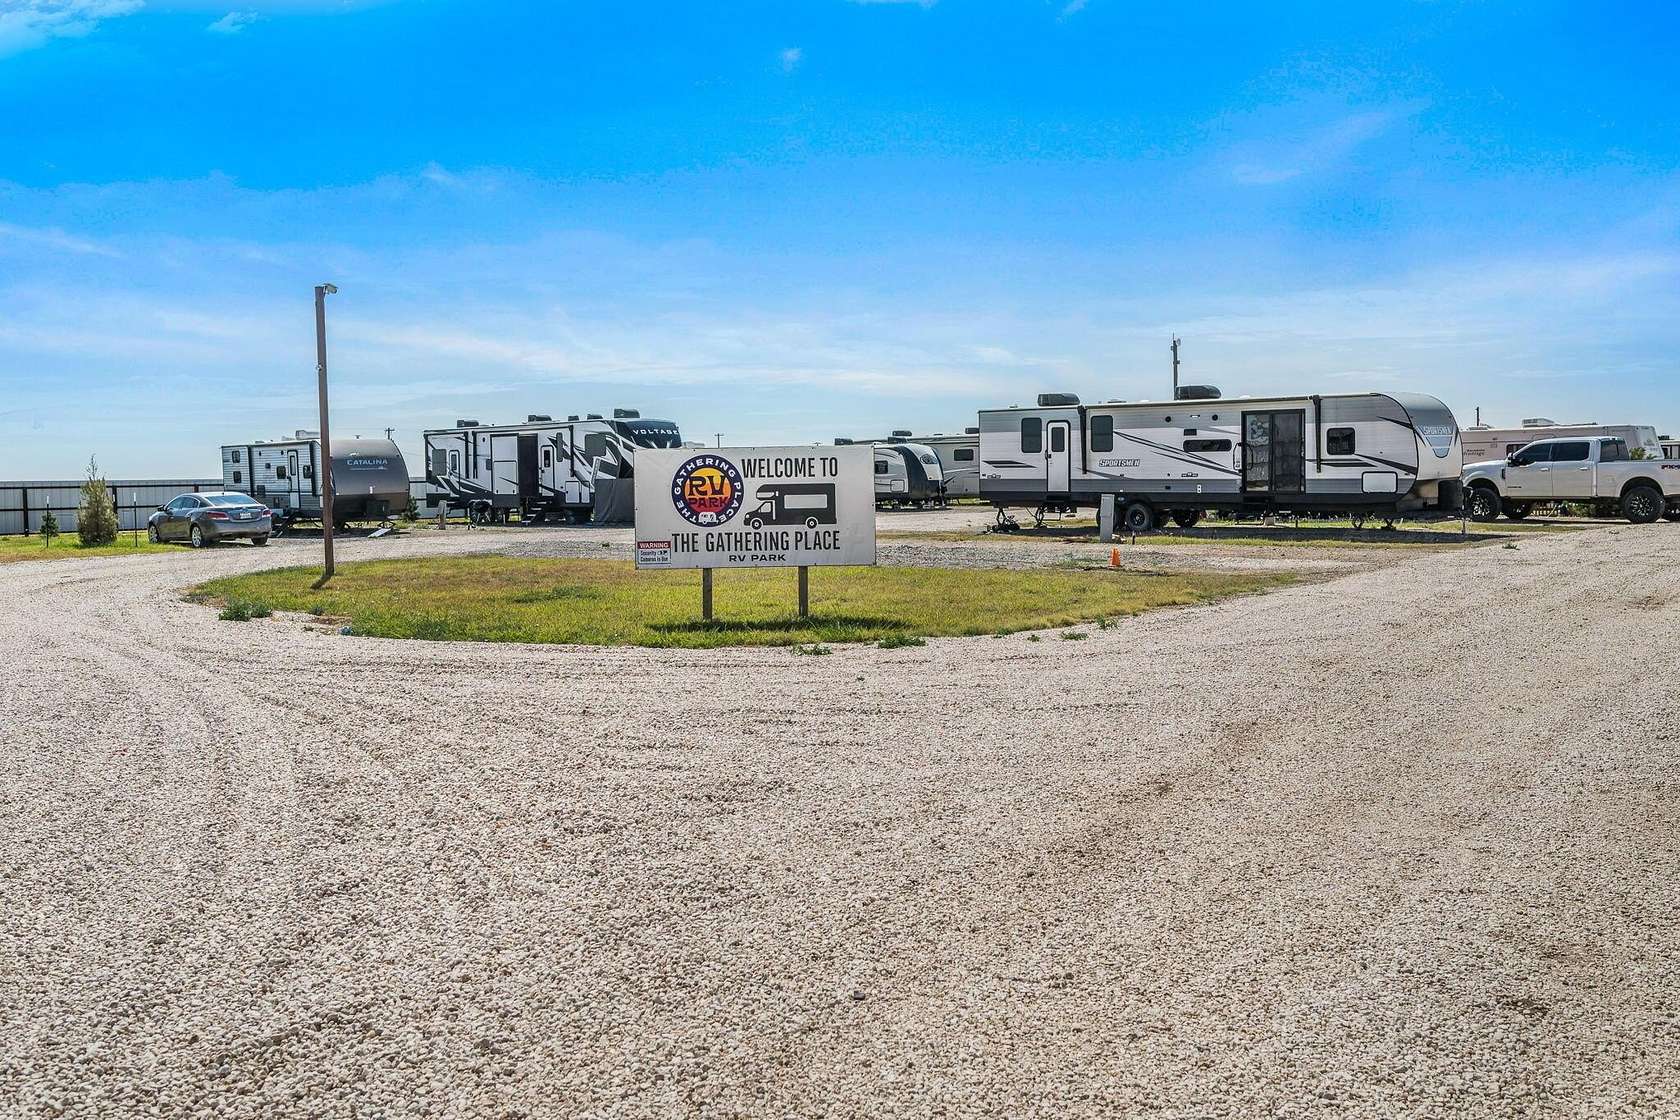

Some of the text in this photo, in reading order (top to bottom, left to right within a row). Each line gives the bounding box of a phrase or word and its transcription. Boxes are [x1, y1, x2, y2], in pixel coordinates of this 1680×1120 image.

[742, 457, 838, 478] WELCOME TO
[1099, 459, 1140, 467] SPORTSMEN
[674, 458, 742, 523] THE GATHERING PLACE
[688, 475, 726, 496] RV
[687, 497, 729, 508] PARK
[672, 530, 840, 553] THE GATHERING PLACE
[729, 553, 786, 562] RV PARK
